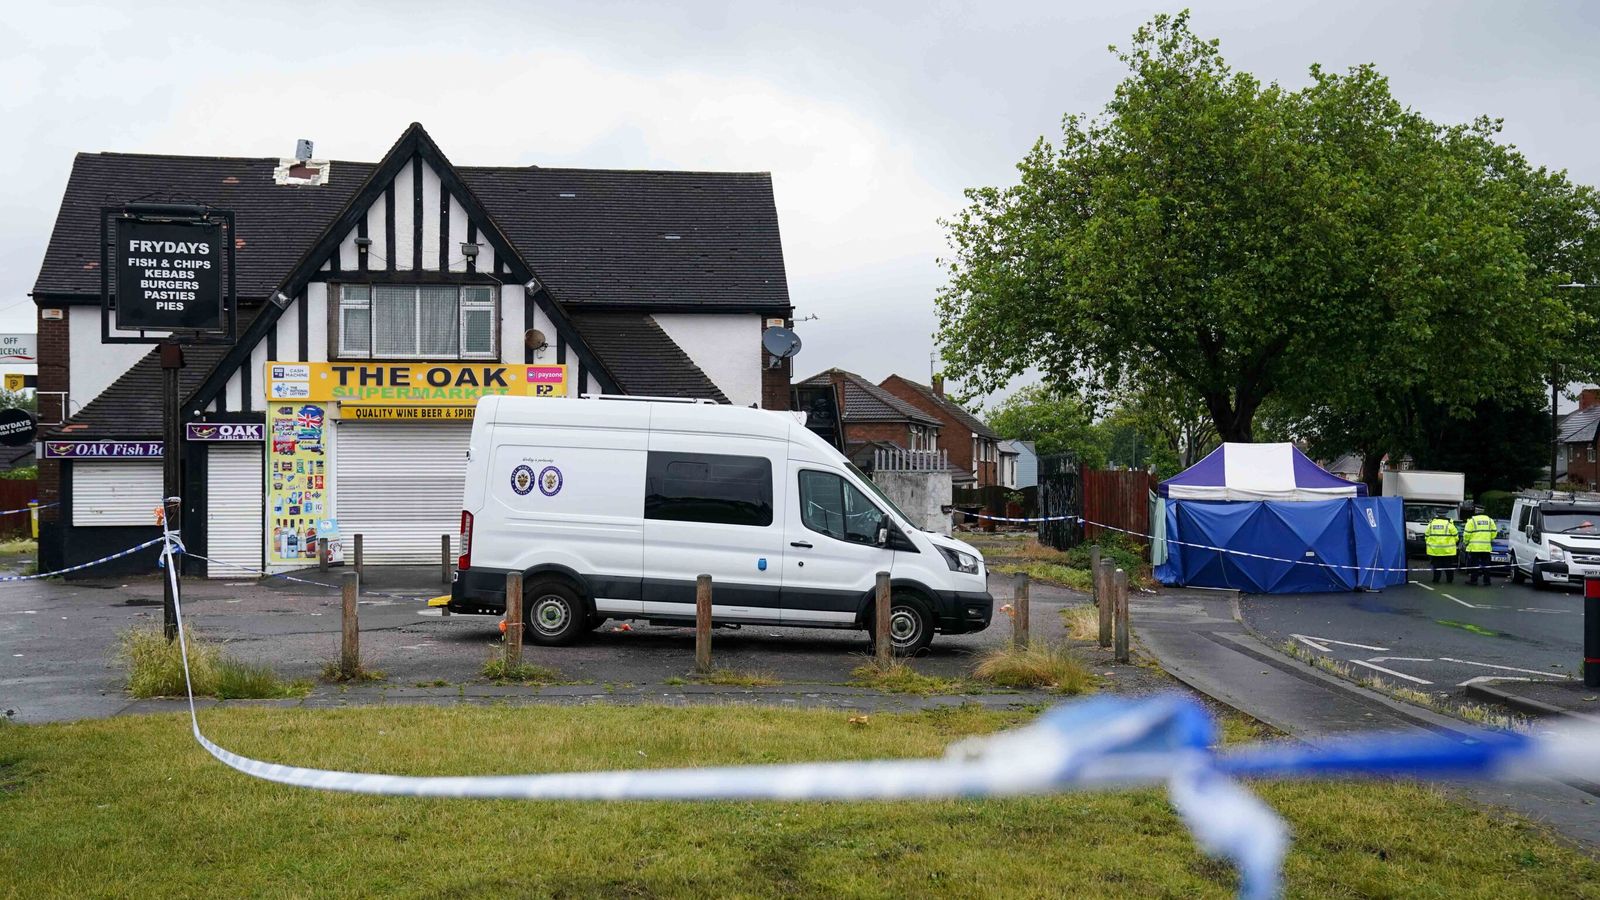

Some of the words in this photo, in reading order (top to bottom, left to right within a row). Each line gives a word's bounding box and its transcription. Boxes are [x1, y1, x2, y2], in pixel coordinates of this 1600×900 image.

[129, 240, 210, 255] FRYDAYS
[128, 258, 157, 267] FISH
[161, 259, 170, 267] &
[174, 259, 211, 269] CHIPS
[145, 269, 195, 279] KEBABS
[140, 279, 199, 290] BURGERS
[144, 290, 196, 301] PASTIES
[156, 301, 184, 311] PIES
[3, 337, 18, 345] OFF
[0, 347, 28, 356] ICENCE
[332, 366, 410, 386] THE
[426, 367, 508, 386] OAK
[537, 372, 563, 381] payzone
[332, 386, 509, 399] SUPERMARKET
[355, 408, 393, 418] QUALITY
[396, 408, 418, 418] WINE
[421, 409, 442, 418] BEER
[446, 409, 451, 418] &
[454, 409, 476, 418] SPIRI
[0, 419, 32, 431] RYDAYS
[219, 425, 259, 436] OAK
[75, 444, 109, 455] OAK
[113, 443, 144, 455] Fish
